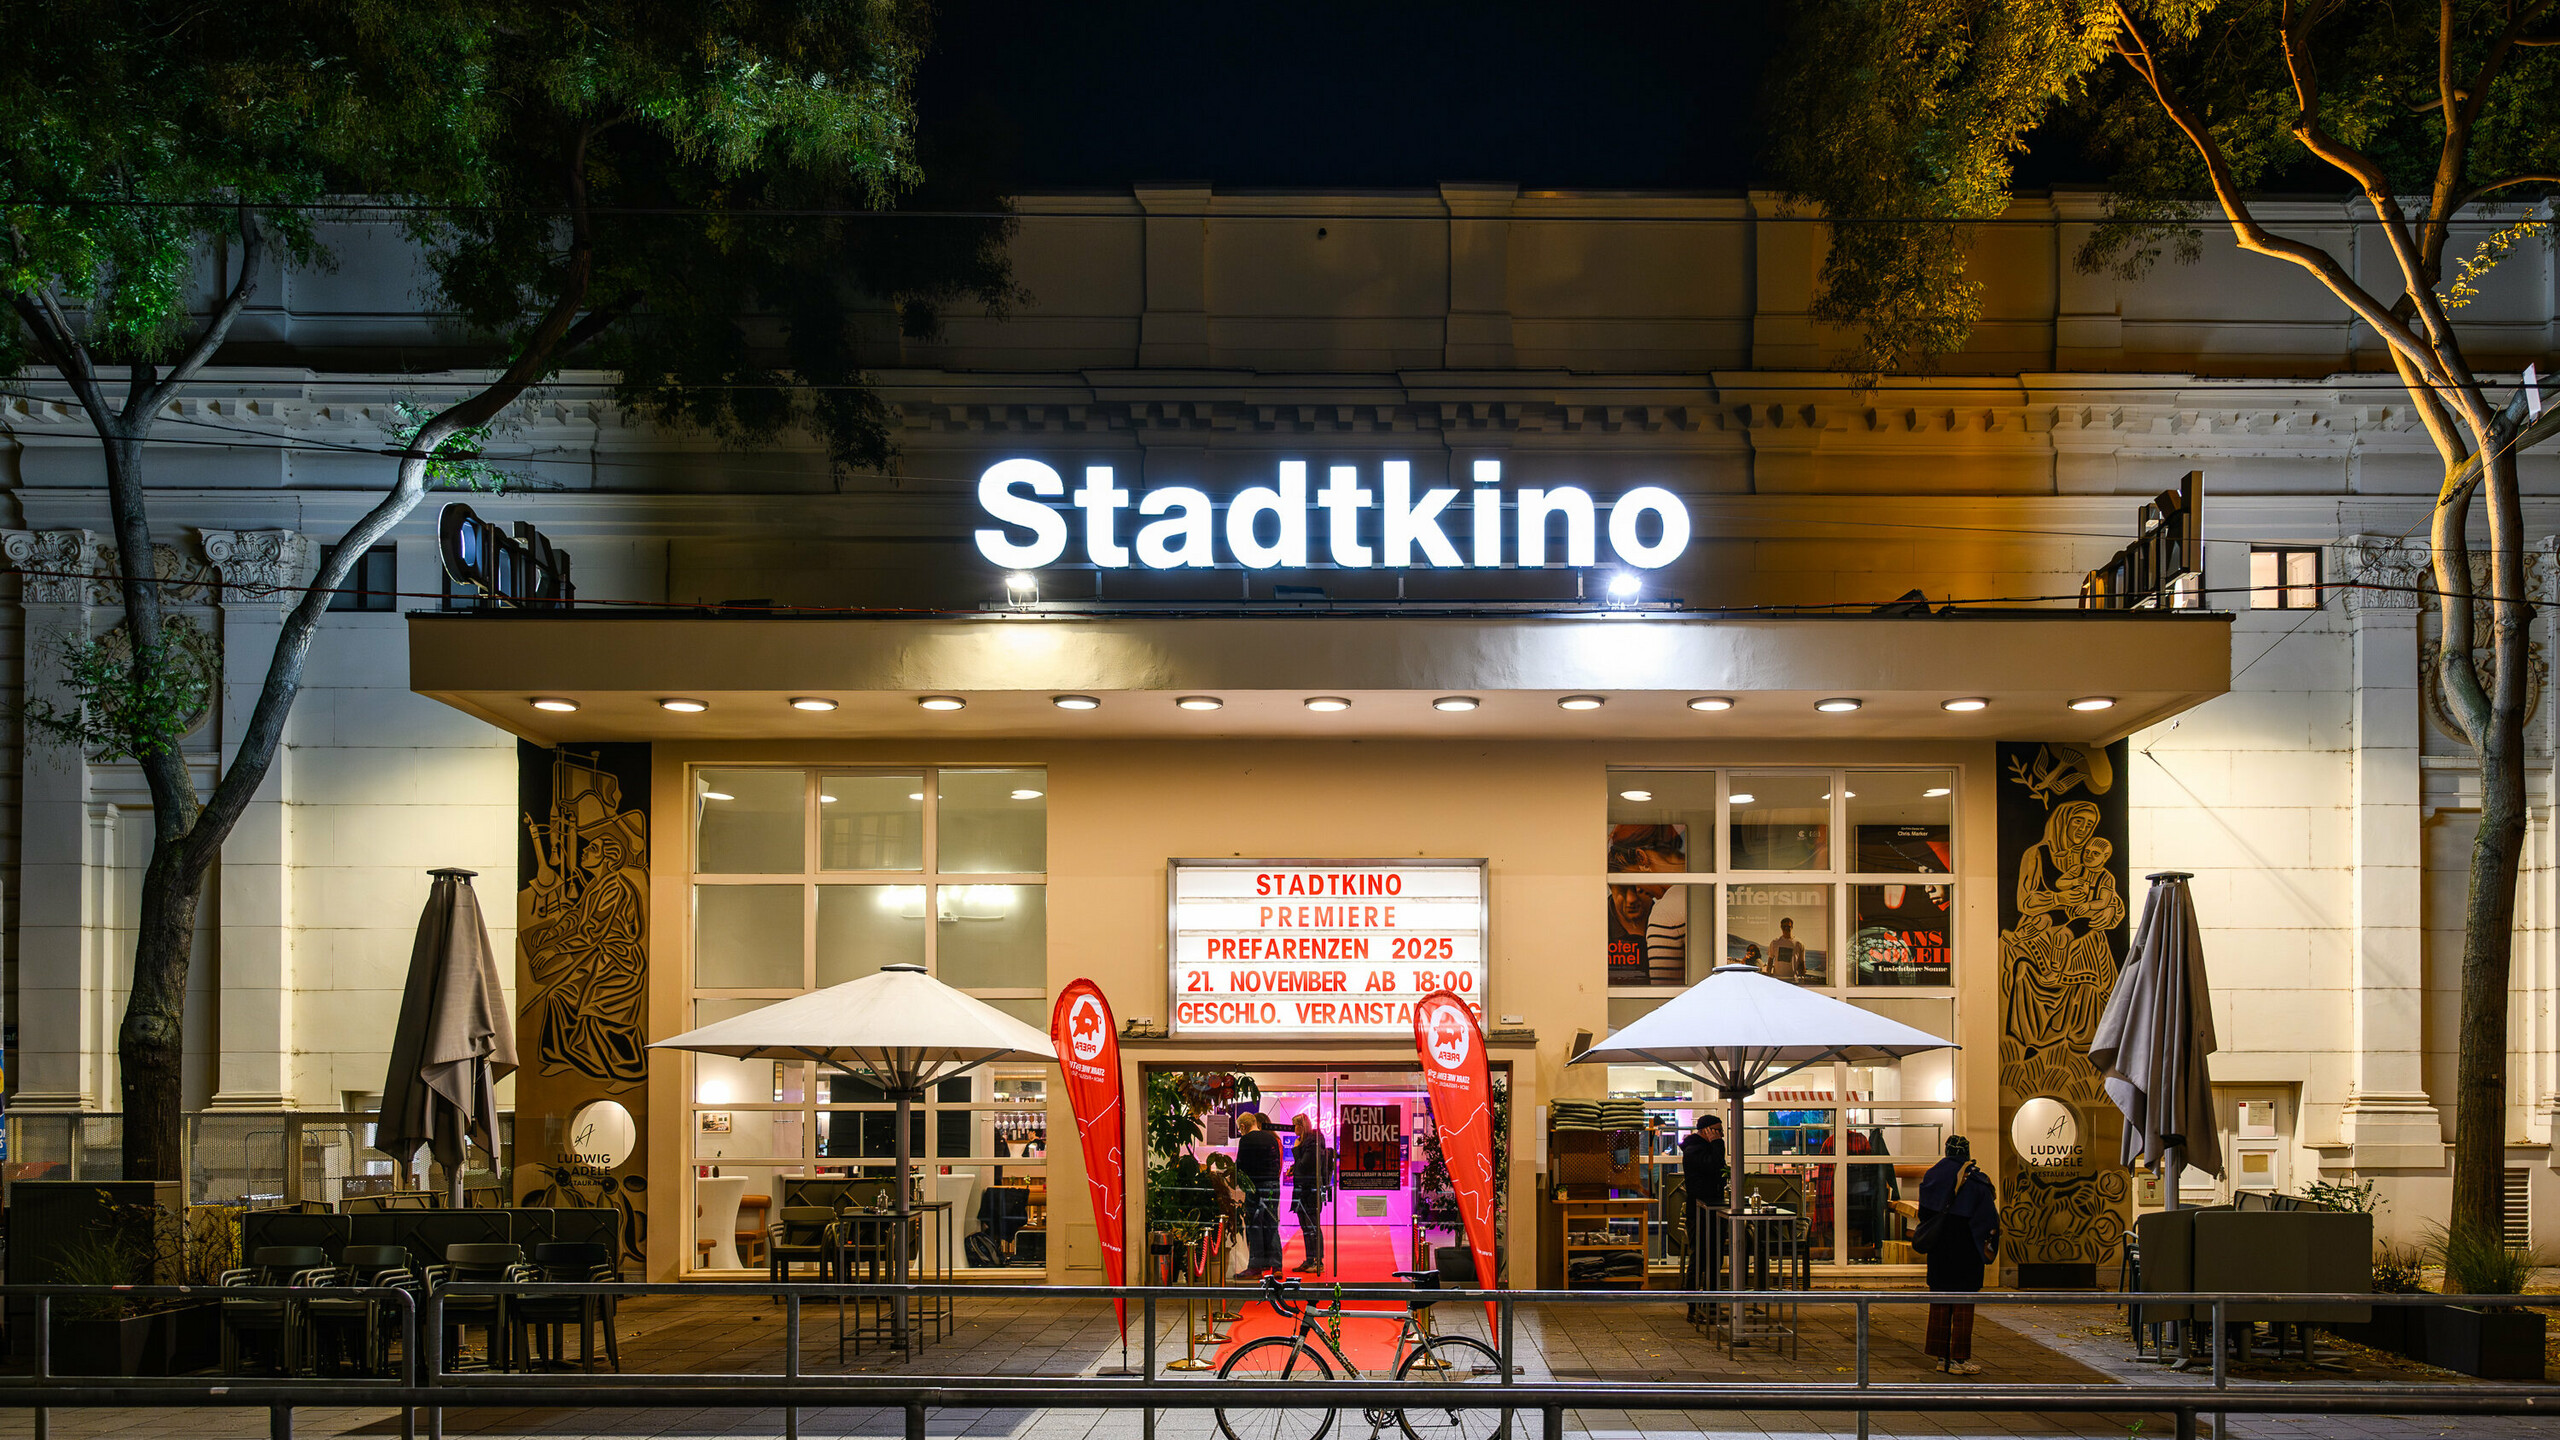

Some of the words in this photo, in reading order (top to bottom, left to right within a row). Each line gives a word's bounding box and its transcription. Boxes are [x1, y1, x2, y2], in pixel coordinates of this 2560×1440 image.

[975, 460, 1691, 569] Stadtkino
[1256, 874, 1401, 896] STADTKINO
[1260, 906, 1396, 928] PREMIERE
[1608, 940, 1638, 953] oter
[1884, 931, 1943, 947] SANS
[1207, 938, 1368, 960] PREFARENZEN
[1391, 938, 1453, 960] 2025
[1187, 971, 1214, 992] 21.
[1230, 971, 1347, 993] NOVEMBER
[1365, 971, 1396, 992] AB
[1412, 971, 1473, 993] 18:00
[1177, 1003, 1281, 1025] GESCHLO.
[1341, 1107, 1384, 1124] AGENT
[1353, 1124, 1399, 1142] BURKE
[557, 1153, 611, 1164] LUDWIG
[2030, 1145, 2083, 1155] LUDWIG
[2031, 1157, 2040, 1167] &
[2044, 1157, 2083, 1167] ADELE
[571, 1166, 611, 1176] ADELE
